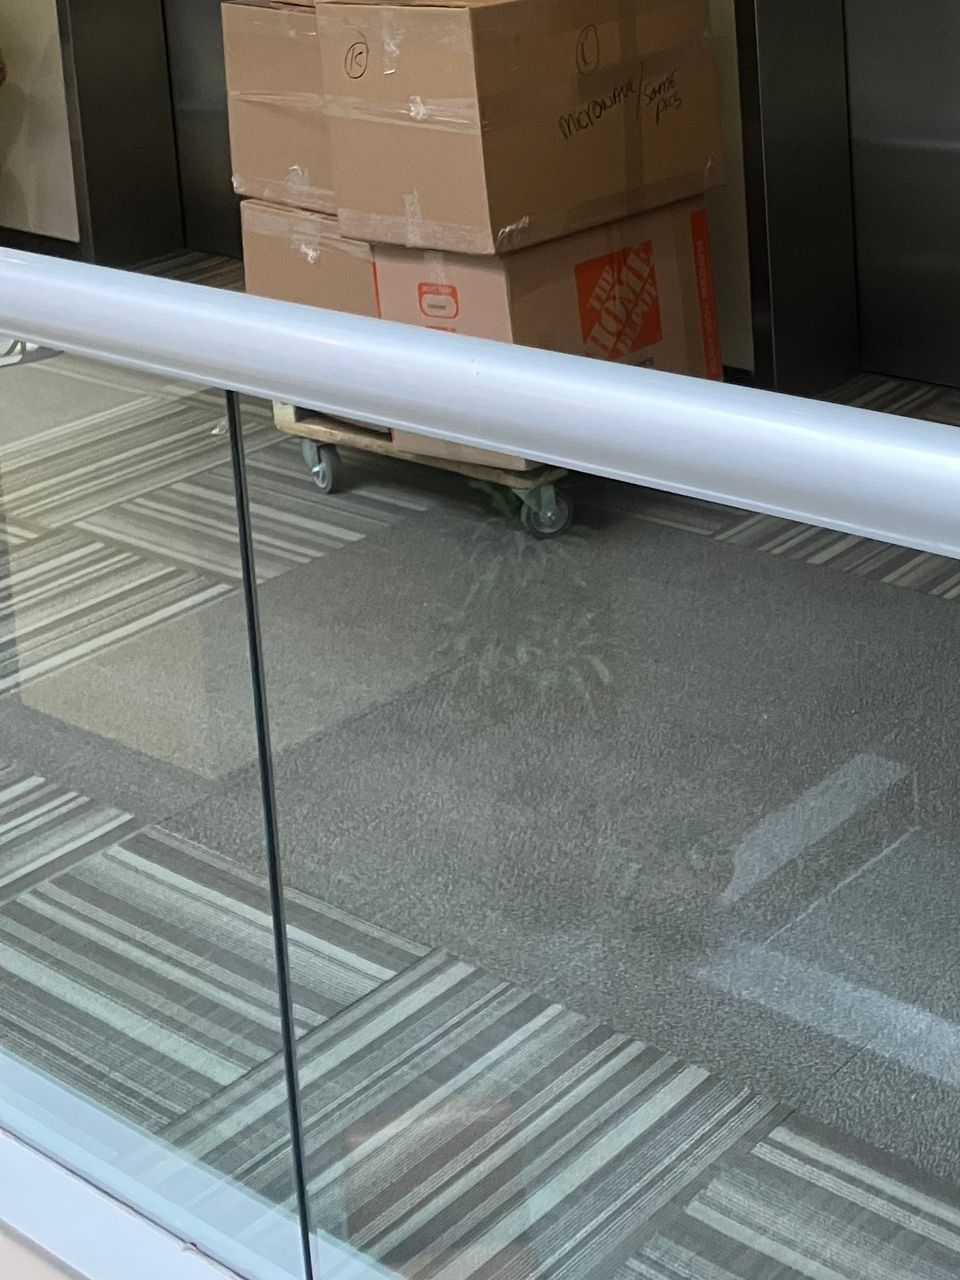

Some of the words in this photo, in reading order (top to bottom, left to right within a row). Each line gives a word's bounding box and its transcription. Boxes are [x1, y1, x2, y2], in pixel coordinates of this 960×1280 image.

[584, 242, 654, 358] HOME
[587, 265, 615, 311] THE
[612, 278, 658, 355] DEPOT
